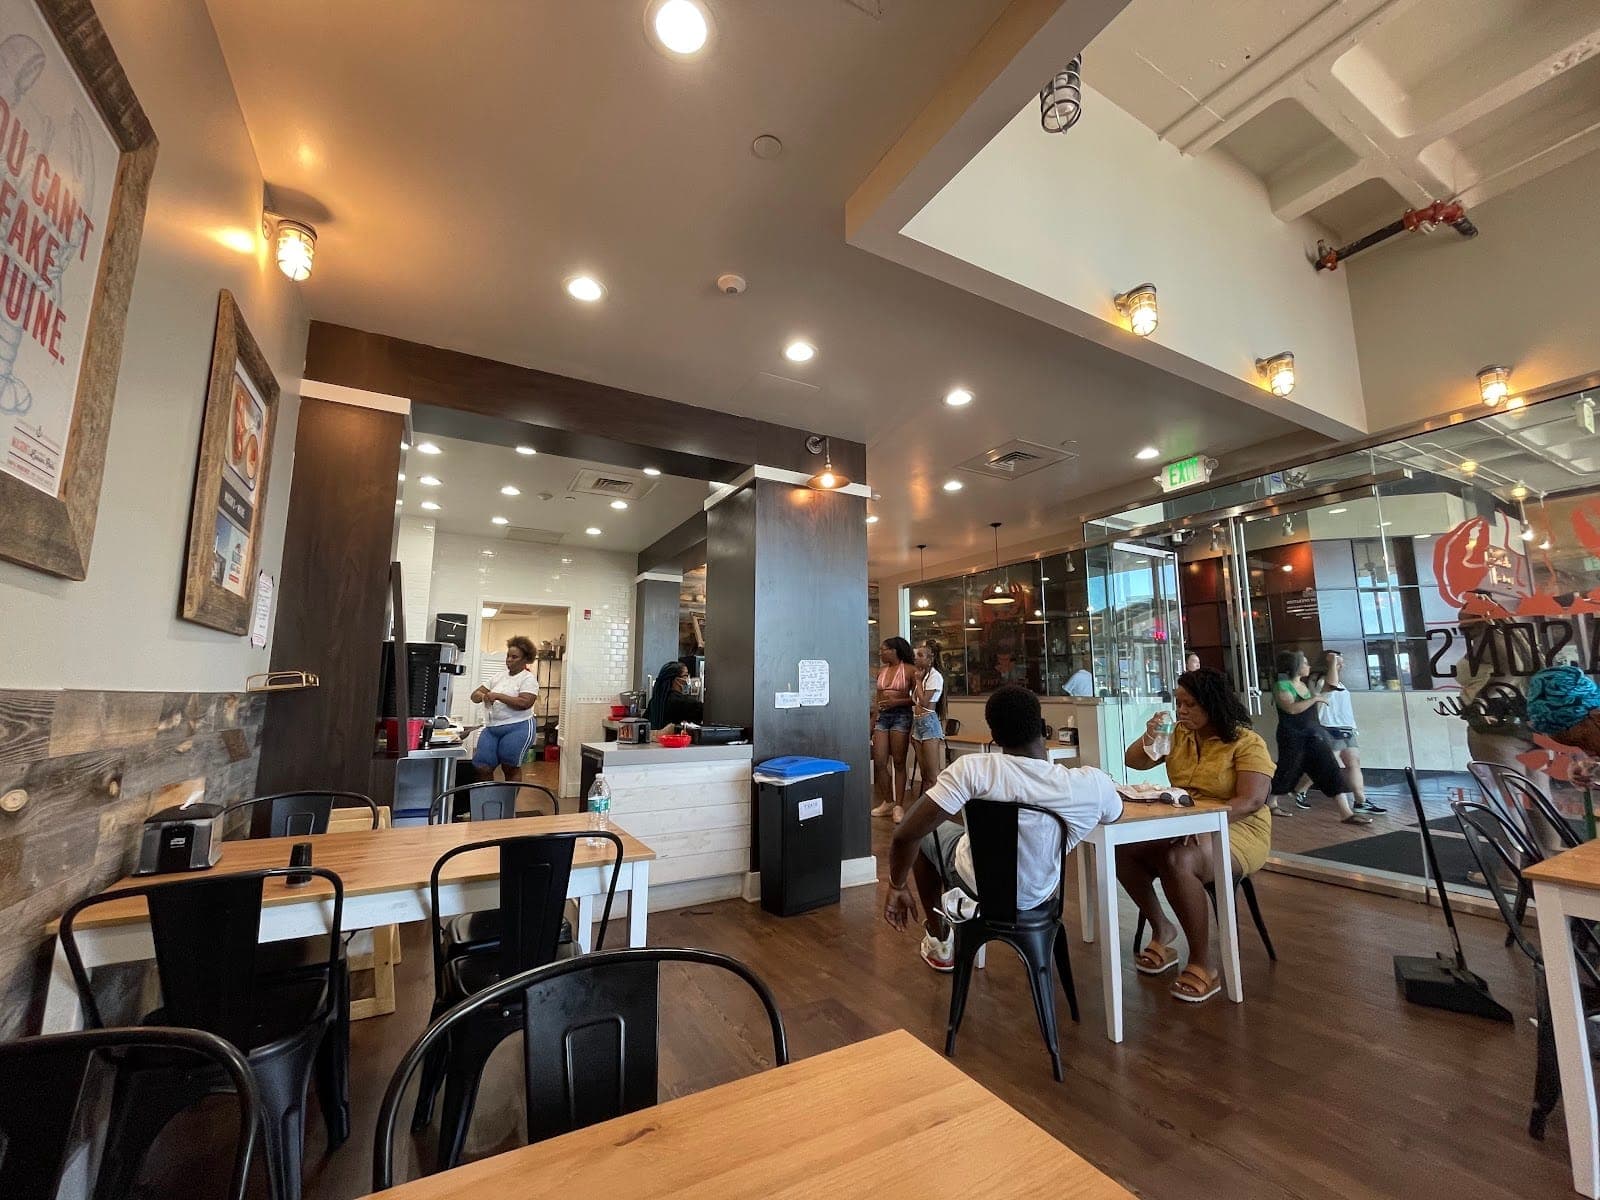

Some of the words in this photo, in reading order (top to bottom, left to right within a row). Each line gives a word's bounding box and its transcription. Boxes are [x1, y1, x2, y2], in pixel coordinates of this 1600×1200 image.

[0, 180, 61, 286] FAKE
[32, 153, 94, 262] CAN'T
[1168, 456, 1198, 486] EXIT
